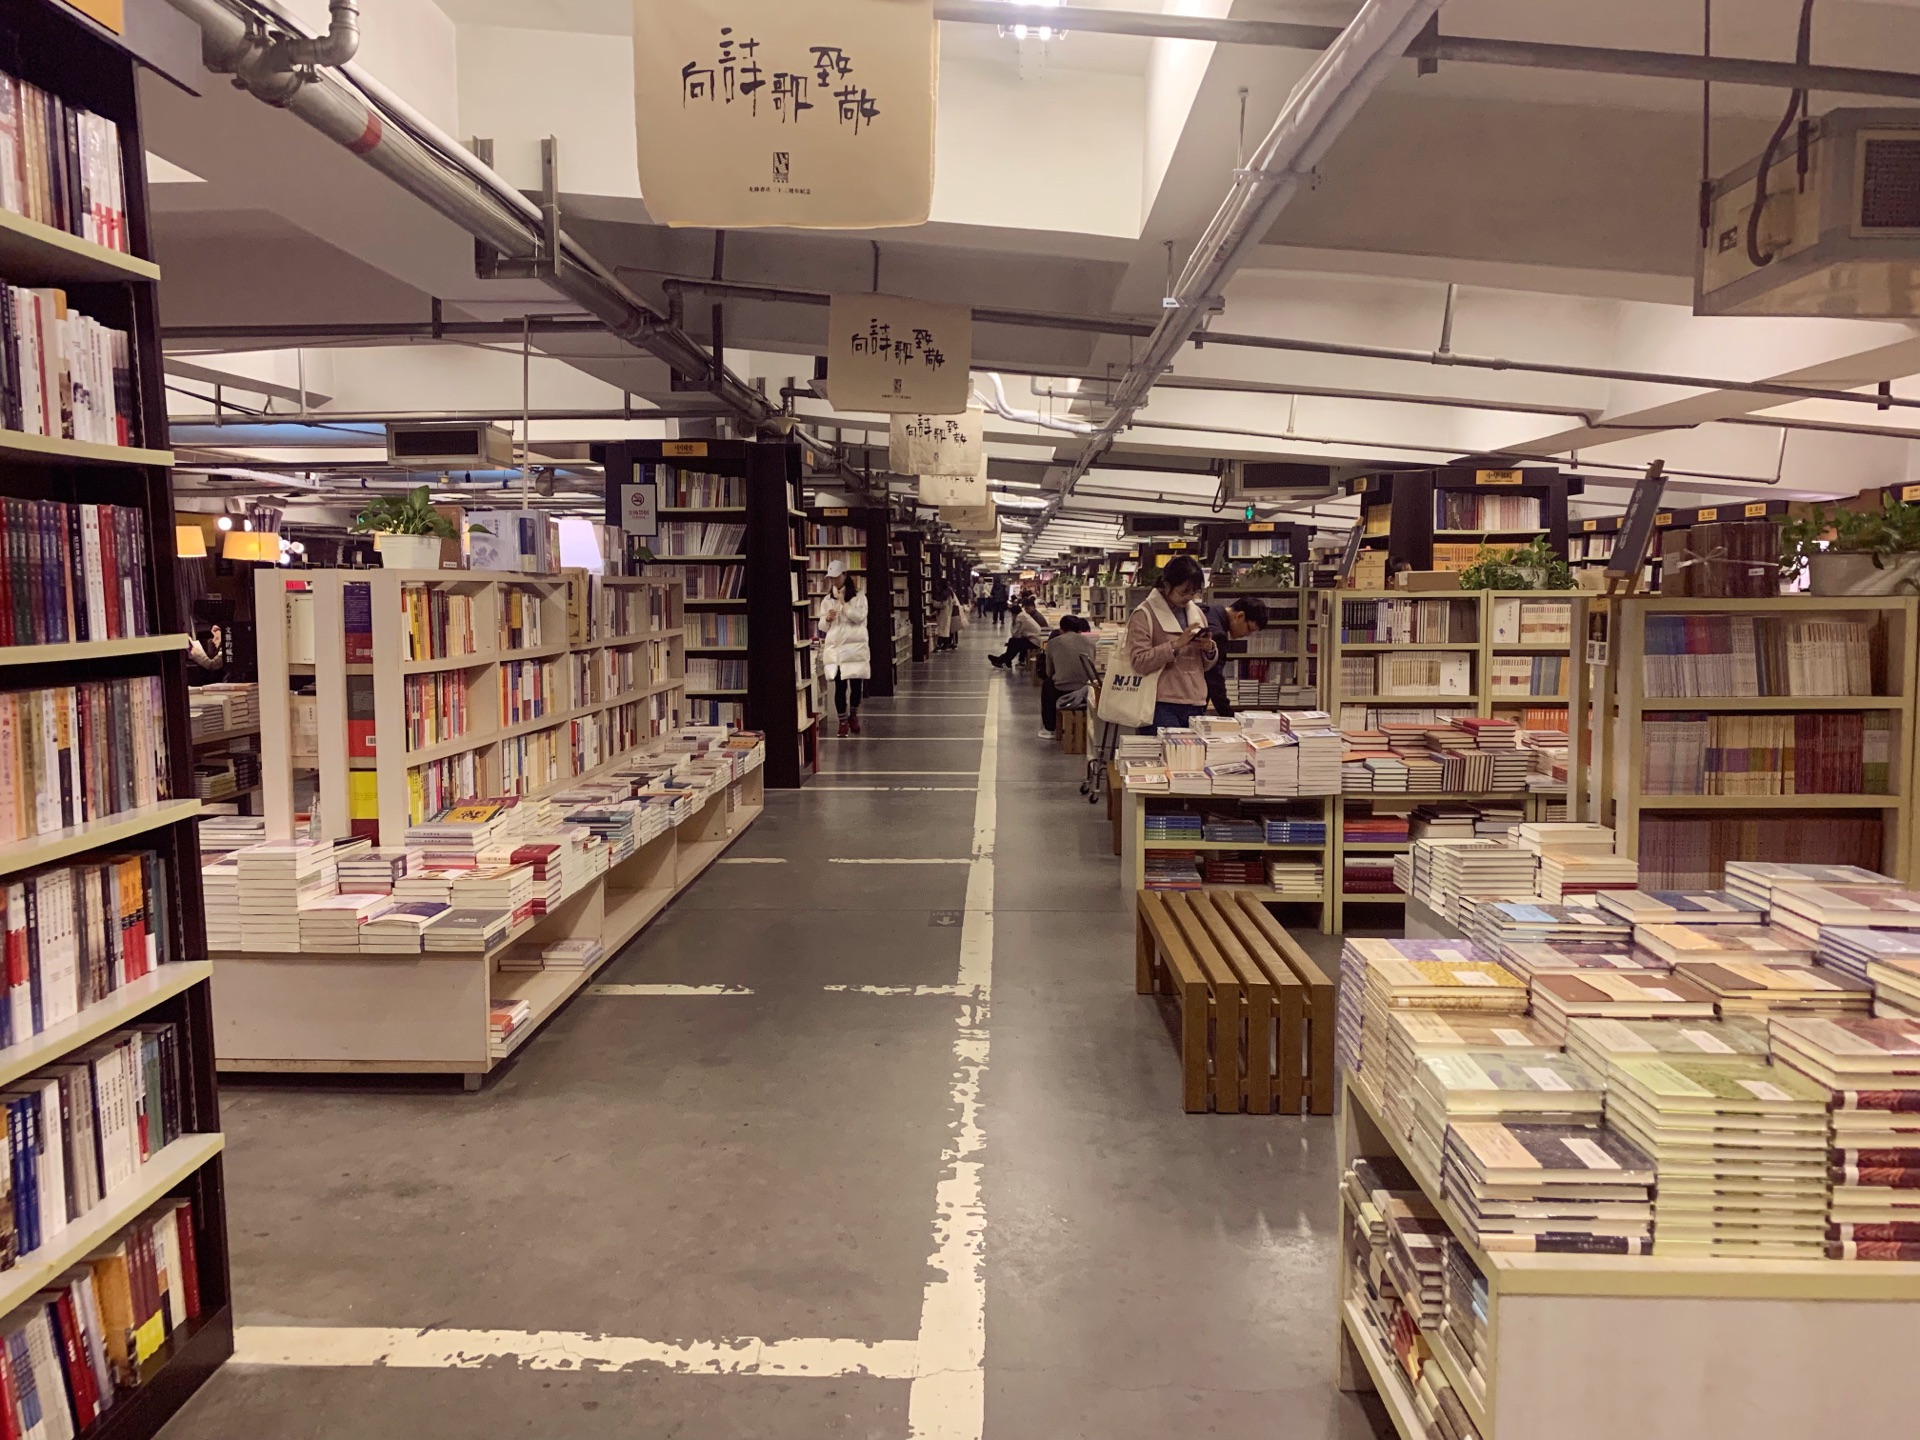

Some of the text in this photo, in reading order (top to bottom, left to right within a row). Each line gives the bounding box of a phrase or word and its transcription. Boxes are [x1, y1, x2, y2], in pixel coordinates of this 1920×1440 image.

[682, 27, 880, 135] 向詩歌致敬
[851, 318, 945, 371] 向詩歌致敬
[1113, 674, 1142, 687] NJU
